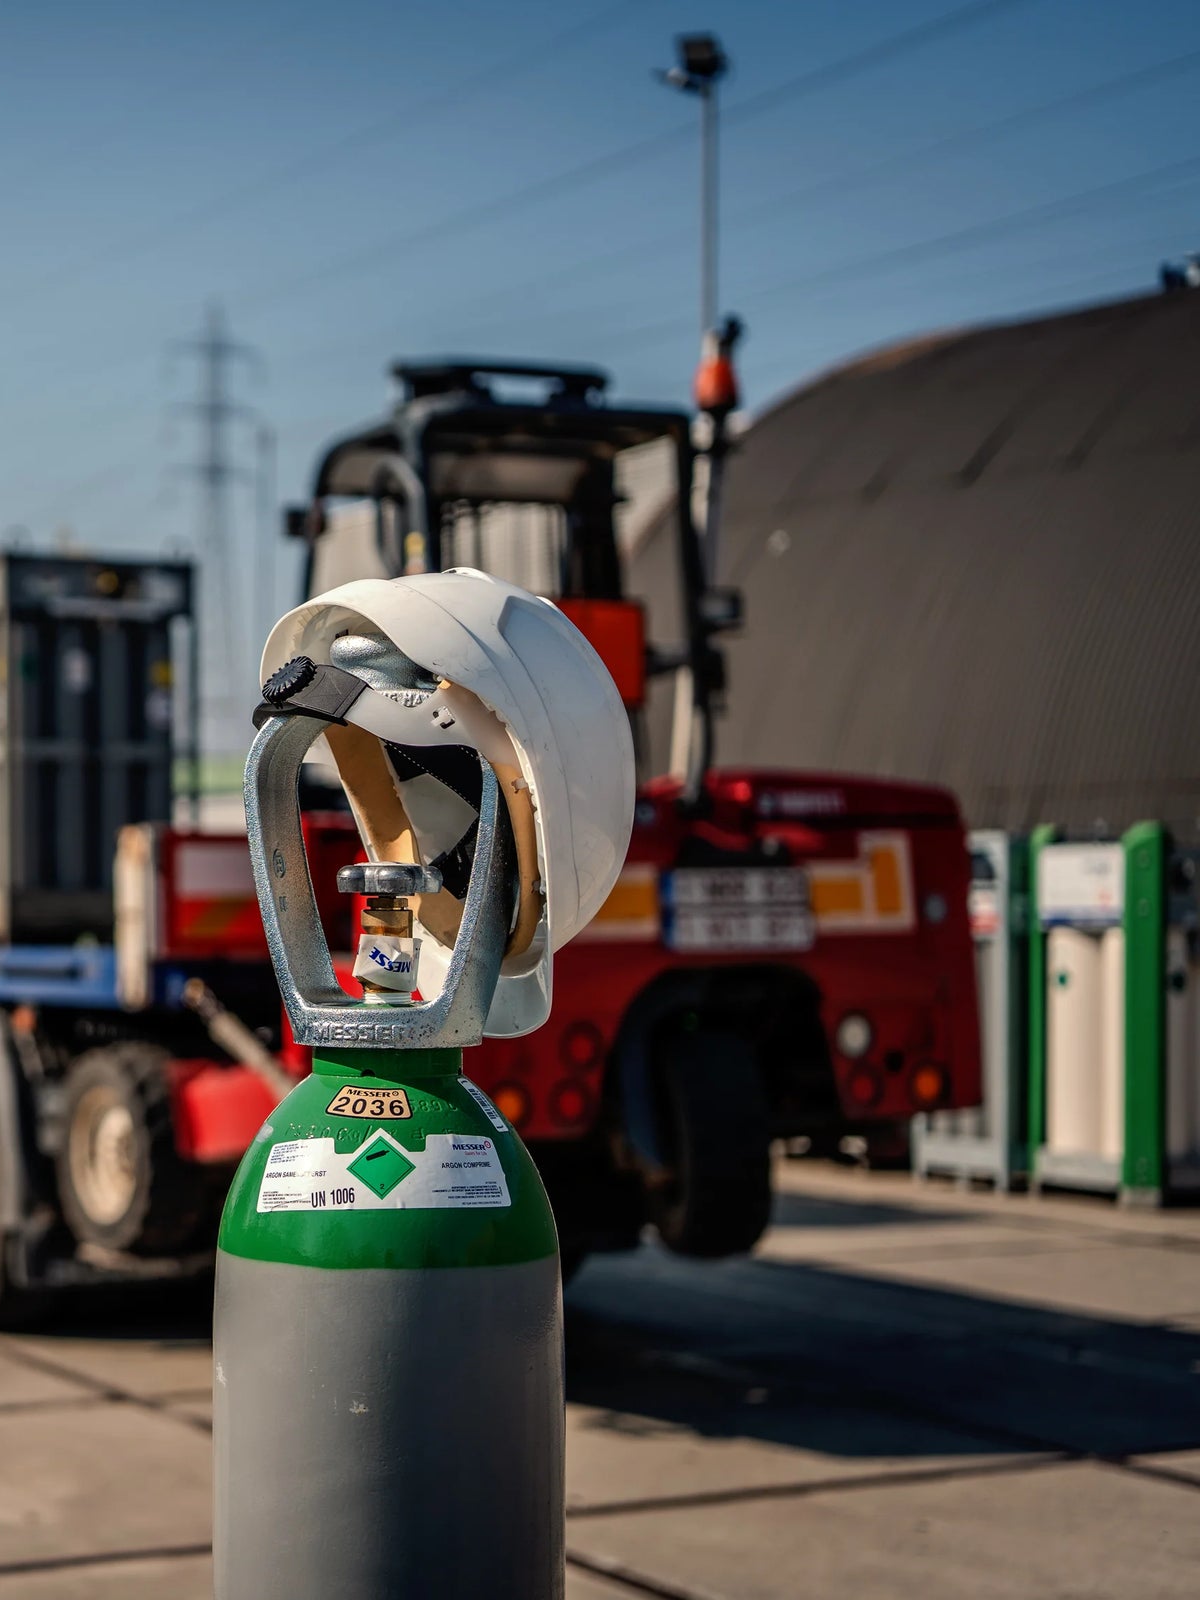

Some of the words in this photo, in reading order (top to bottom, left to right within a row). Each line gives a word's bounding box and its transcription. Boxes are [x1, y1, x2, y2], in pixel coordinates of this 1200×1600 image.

[310, 1021, 407, 1041] MESSER
[346, 1088, 391, 1098] MESSER
[332, 1096, 404, 1116] 2036
[452, 1143, 486, 1151] MESSER
[265, 1171, 282, 1179] ARGON
[311, 1192, 326, 1208] UN
[330, 1187, 355, 1205] 1006
